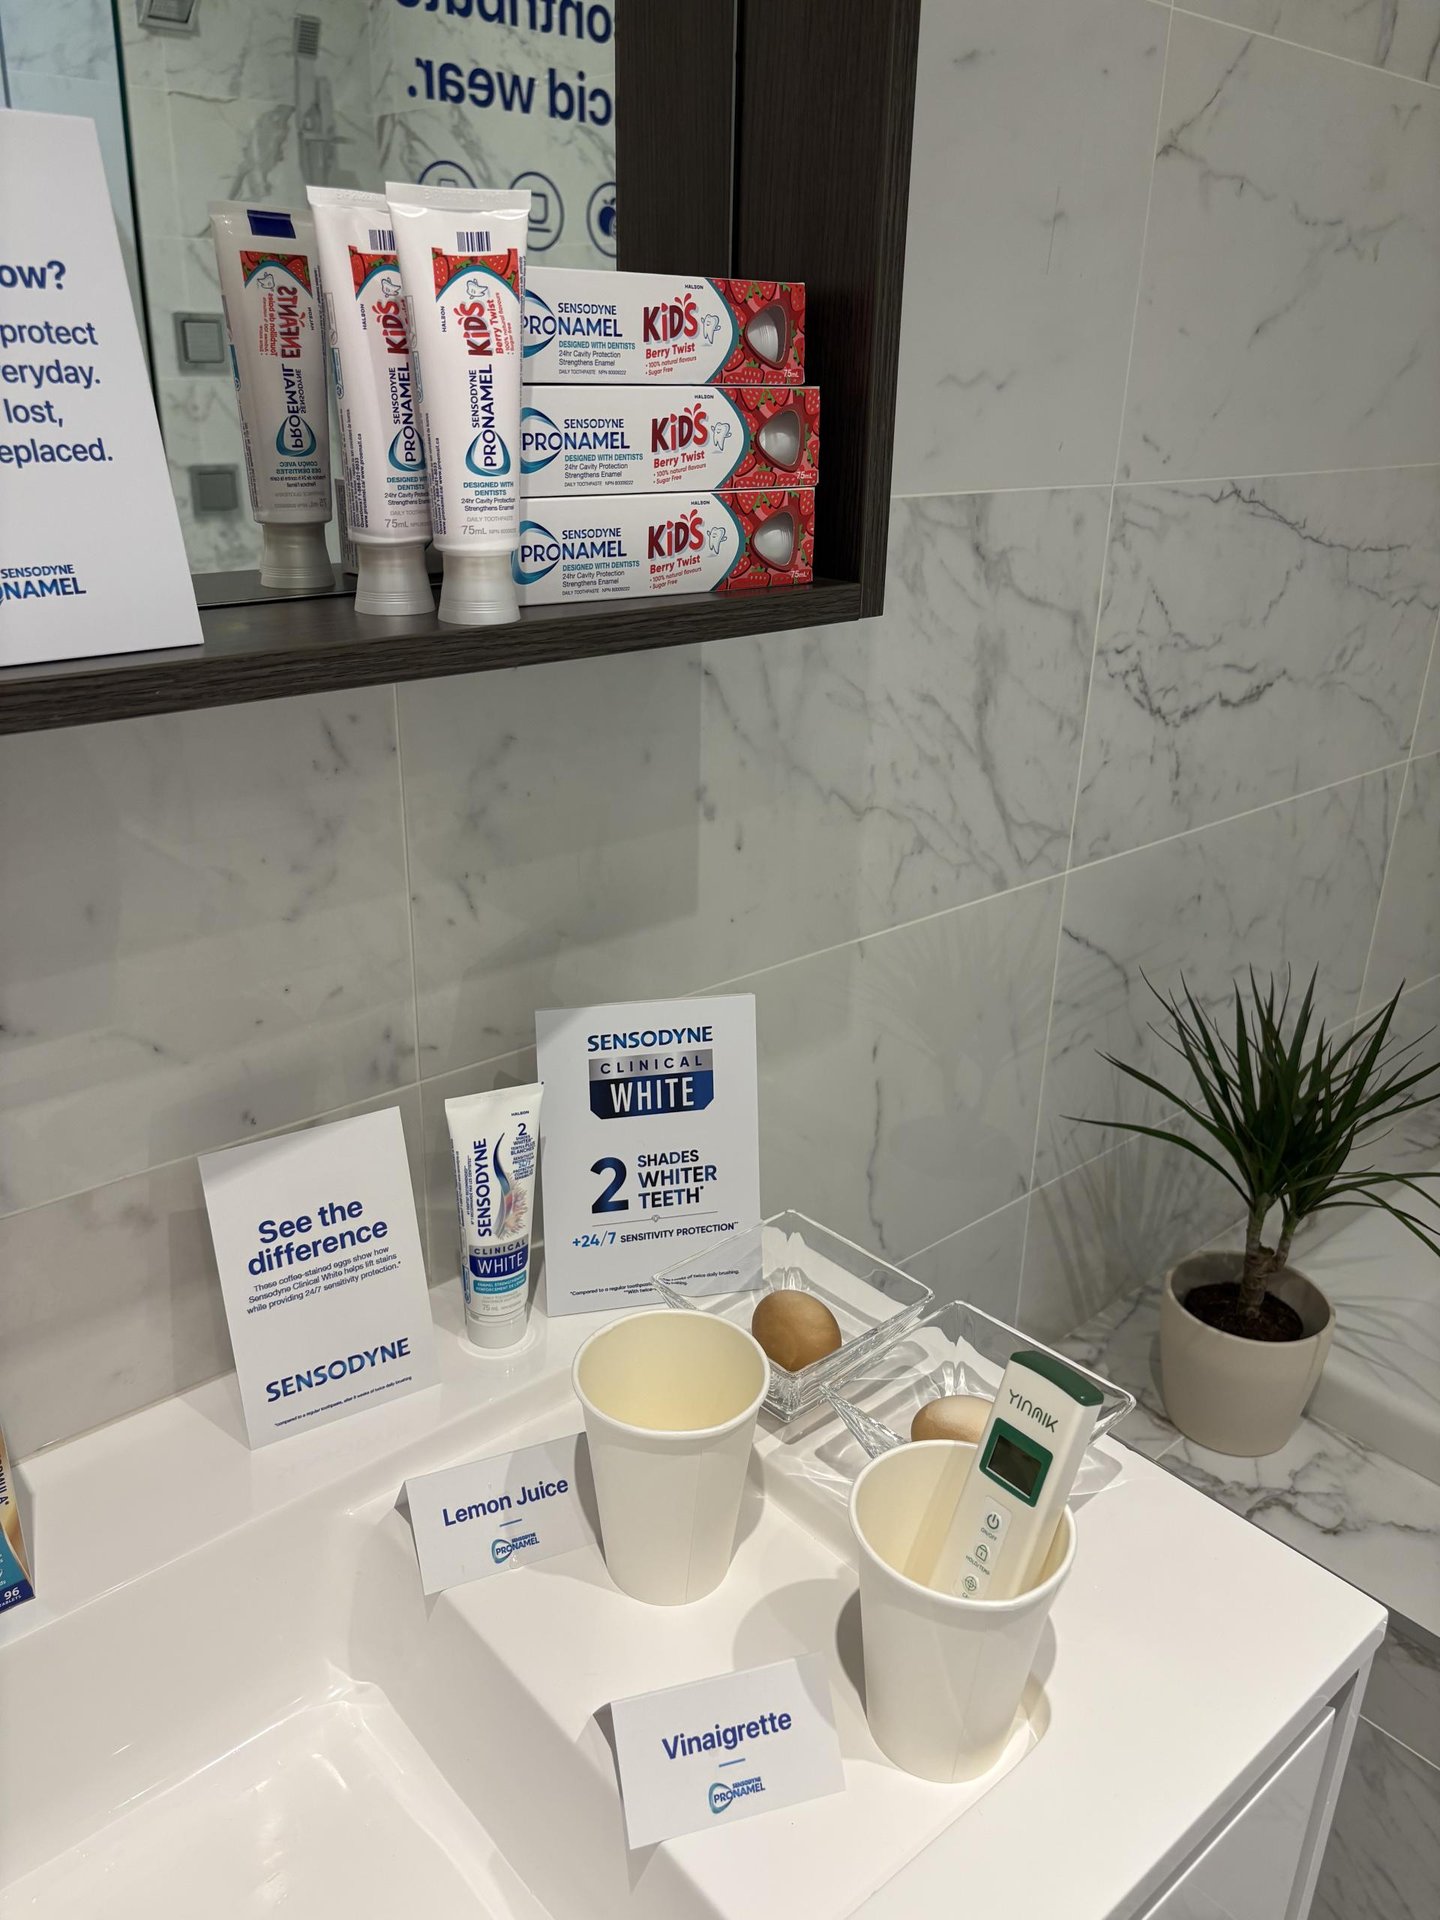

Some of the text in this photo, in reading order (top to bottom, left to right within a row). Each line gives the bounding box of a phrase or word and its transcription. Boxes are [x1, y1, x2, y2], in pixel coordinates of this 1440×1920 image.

[558, 302, 617, 315] SENSODYNE
[0, 320, 99, 349] protect
[487, 299, 505, 355] Berry Twist
[559, 341, 590, 349] DESIGNED
[607, 342, 636, 350] DENTISTS
[573, 350, 591, 359] Cavity
[592, 350, 621, 358] Protection
[646, 342, 695, 359] Berry Twist
[0, 359, 101, 389] eryday.
[559, 359, 593, 367] Strengthens
[388, 367, 401, 425] SENSODYNE
[469, 369, 480, 428] SENSODYNE
[4, 398, 63, 428] lost,
[397, 361, 416, 463] PRONAMEL
[478, 364, 497, 467] PRONAMEL
[564, 418, 624, 429] SENSODYNE
[522, 431, 630, 451] PRONAMEL
[564, 454, 596, 462] DESIGNED
[614, 453, 644, 461] DENTISTS
[579, 463, 597, 471] Cavity
[653, 450, 705, 469] Berry Twist
[562, 528, 622, 540] SENSODYNE
[521, 540, 627, 563] PRONAMEL
[0, 564, 75, 579] SENSODYNE
[562, 561, 640, 572] DESIGNED WITH DENTISTS
[577, 571, 595, 580] Cavity
[650, 555, 701, 574] Berry Twist
[0, 577, 87, 600] NAMEL
[562, 580, 597, 588] Strengthens
[587, 1026, 713, 1052] SENSODYNE
[600, 1055, 703, 1074] CLINICAL
[610, 1077, 695, 1114] WHITE
[517, 1123, 527, 1136] 2
[637, 1149, 699, 1167] SHADES
[590, 1156, 630, 1214] 2
[638, 1164, 717, 1188] WHITER
[473, 1138, 492, 1237] SENSODYNE
[258, 1200, 363, 1244] See the
[248, 1220, 388, 1276] difference
[474, 1240, 526, 1255] CLINICAL
[572, 1230, 617, 1248] +24/7
[621, 1229, 674, 1243] SENSITIVITY
[254, 1281, 277, 1293] These
[333, 1258, 352, 1270] eggs
[352, 1251, 373, 1264] show
[374, 1246, 390, 1258] how
[477, 1251, 524, 1274] WHITE
[248, 1253, 397, 1304] Sensodyne Clinical White helps lift stains
[247, 1302, 267, 1314] while
[269, 1292, 304, 1310] providing
[305, 1285, 322, 1297] 24/7
[323, 1275, 359, 1292] sensitivity
[266, 1337, 411, 1403] SENSODYNE
[442, 1479, 569, 1527] Lemon Juice
[496, 1536, 540, 1556] PRONAMEL
[4, 1587, 20, 1600] 96
[661, 1712, 793, 1760] Vinaigrette
[713, 1782, 766, 1804] PRONAMEL
